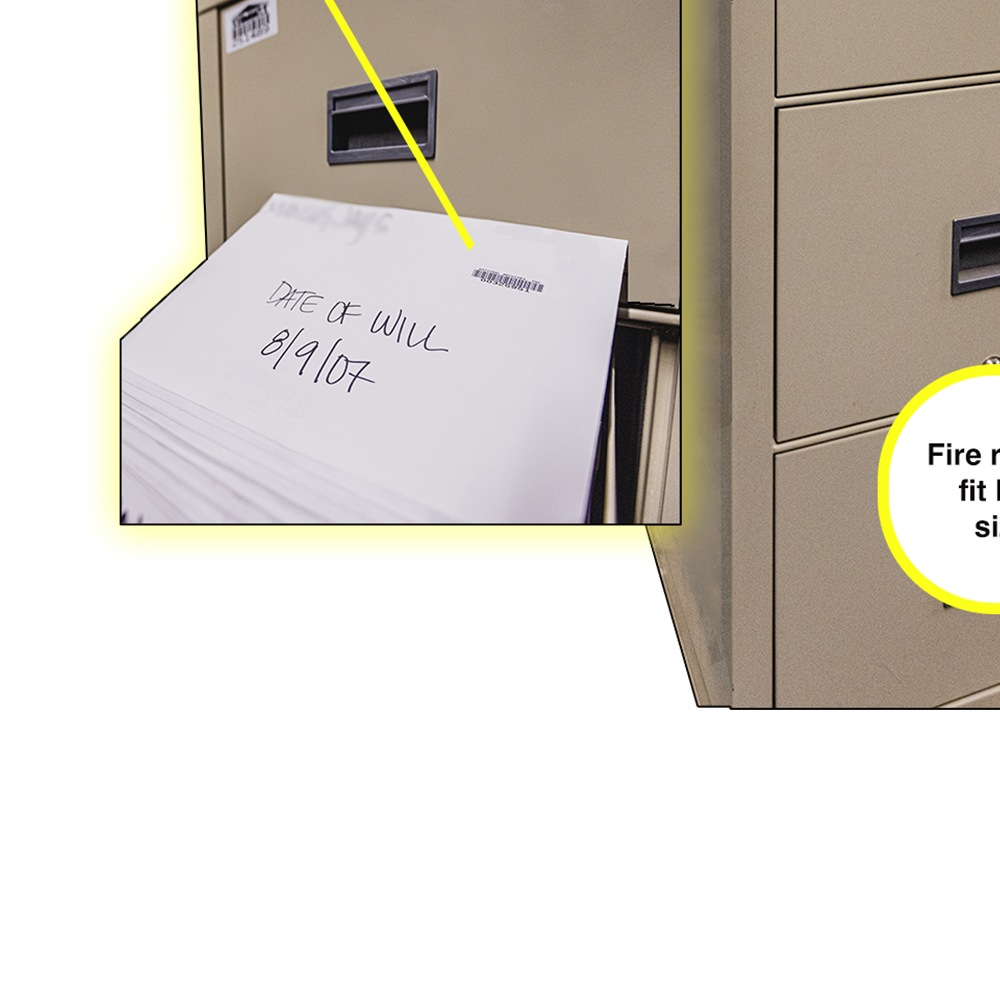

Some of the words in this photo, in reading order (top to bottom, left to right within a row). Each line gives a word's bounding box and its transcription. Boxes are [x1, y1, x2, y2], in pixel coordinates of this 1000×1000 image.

[266, 280, 324, 313] DATE
[327, 301, 362, 325] OF
[370, 309, 449, 352] WILL
[261, 327, 375, 393] 8/9/07
